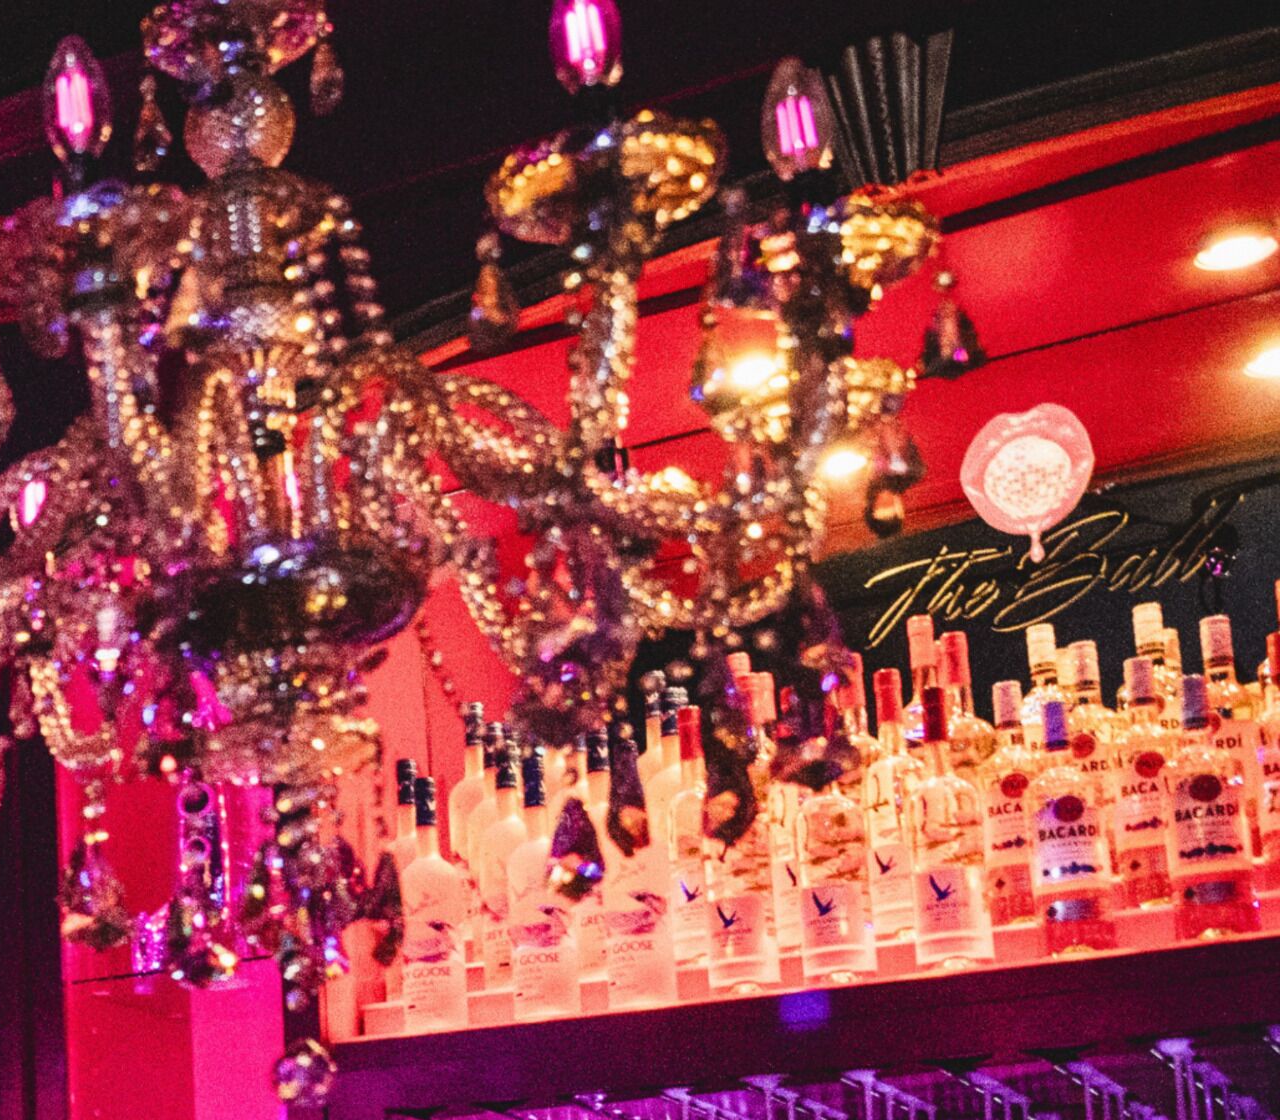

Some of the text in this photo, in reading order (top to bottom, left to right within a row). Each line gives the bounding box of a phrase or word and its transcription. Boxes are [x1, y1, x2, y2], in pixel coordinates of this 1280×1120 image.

[864, 493, 1245, 650] The Ball
[1121, 782, 1159, 797] BACA
[988, 802, 1023, 817] BACA
[612, 939, 653, 953] GOOSE
[520, 953, 560, 966] GOOSE
